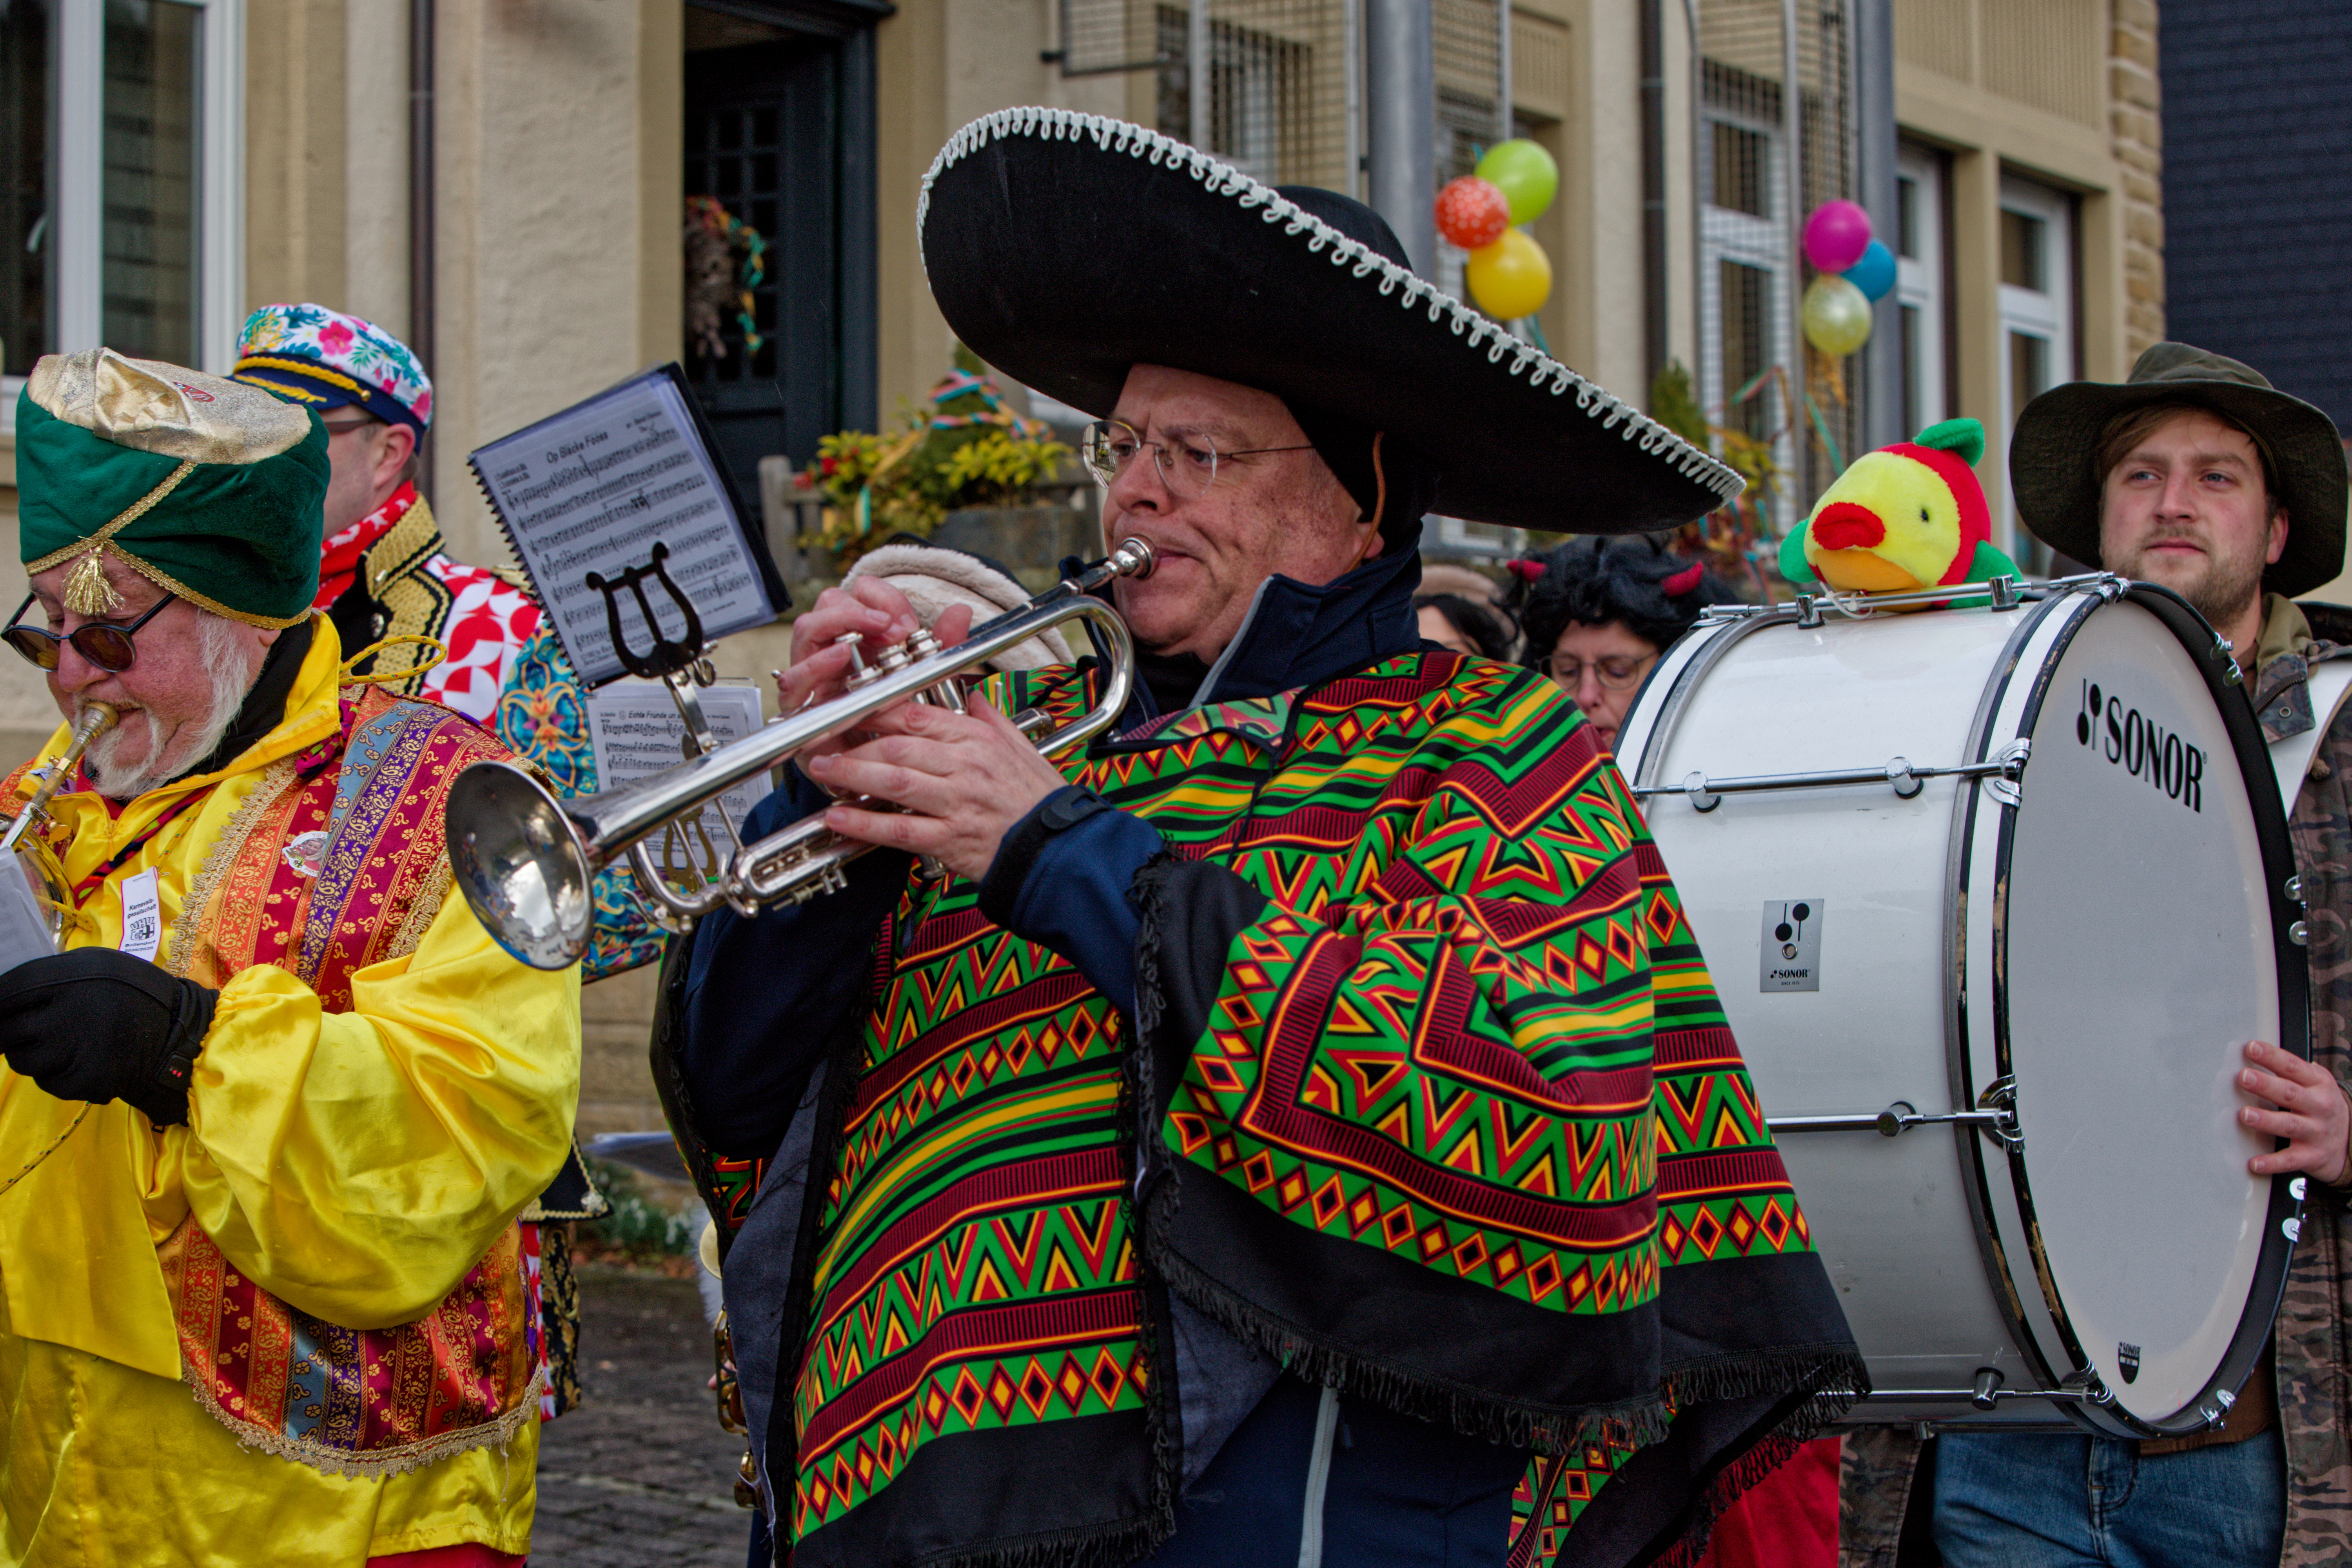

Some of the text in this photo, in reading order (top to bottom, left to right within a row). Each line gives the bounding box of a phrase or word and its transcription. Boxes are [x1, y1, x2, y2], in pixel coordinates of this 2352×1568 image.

[546, 451, 559, 464] Op
[2104, 696, 2202, 813] SONOR
[127, 904, 156, 919] gesellschaft
[129, 898, 154, 911] Karnevals-
[130, 916, 155, 930] UHU
[1779, 969, 1808, 979] SONOR
[2122, 1342, 2141, 1358] SONOR
